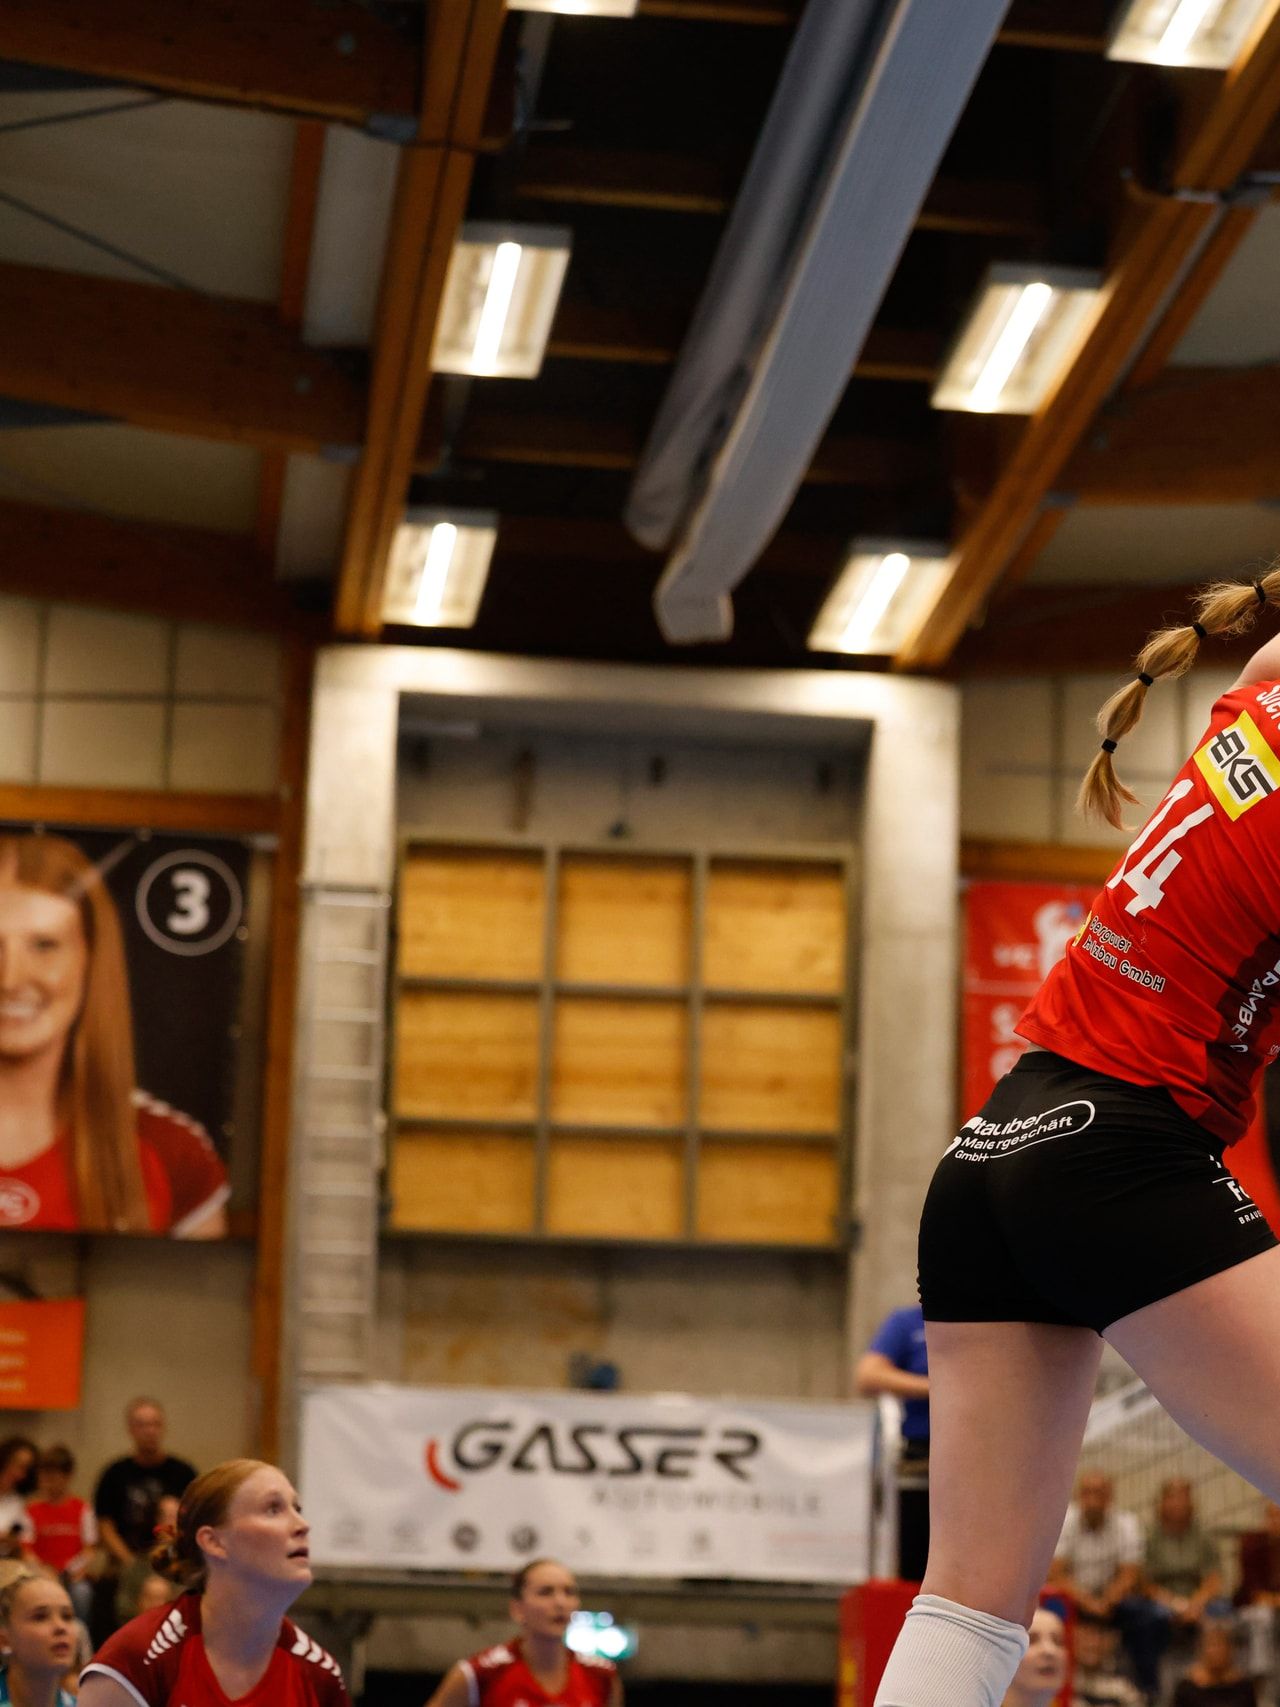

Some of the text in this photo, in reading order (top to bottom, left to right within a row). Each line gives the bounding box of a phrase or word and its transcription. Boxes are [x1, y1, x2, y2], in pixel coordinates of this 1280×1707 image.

[1213, 730, 1273, 801] EKS
[1106, 778, 1214, 918] 14
[166, 869, 211, 934] 3
[1119, 959, 1166, 992] GmbH
[955, 1149, 989, 1162] GmbH
[961, 1116, 1073, 1150] Malergeschäft
[450, 1420, 763, 1482] GASSER
